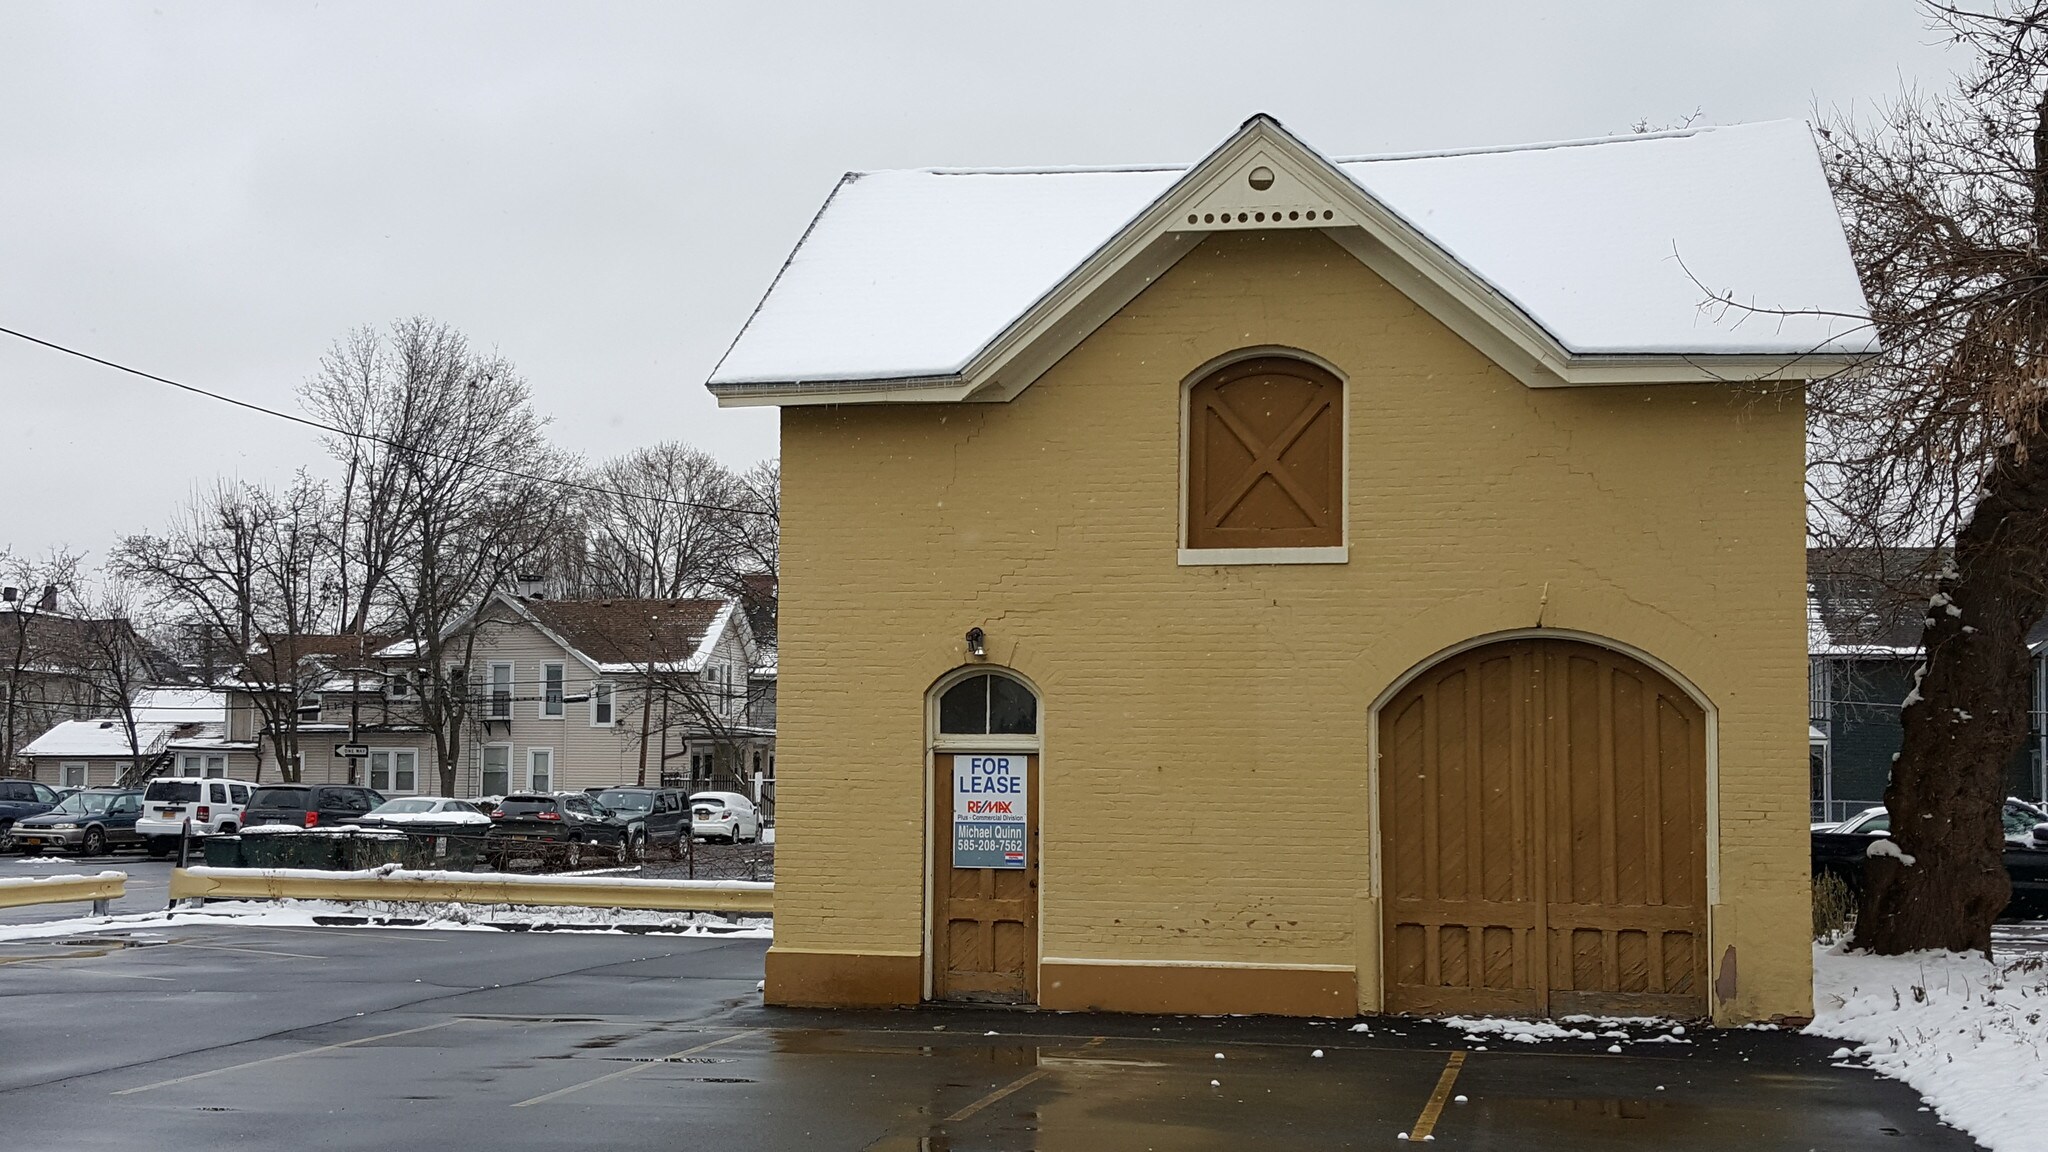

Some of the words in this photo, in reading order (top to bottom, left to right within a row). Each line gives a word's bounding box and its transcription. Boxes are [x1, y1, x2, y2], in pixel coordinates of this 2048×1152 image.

[971, 757, 1010, 775] FOR
[959, 776, 1021, 794] LEASE
[967, 800, 1013, 814] RE/MAX
[958, 825, 992, 838] Michael
[995, 825, 1022, 838] Quinn
[957, 839, 1022, 851] 585-208-7562
